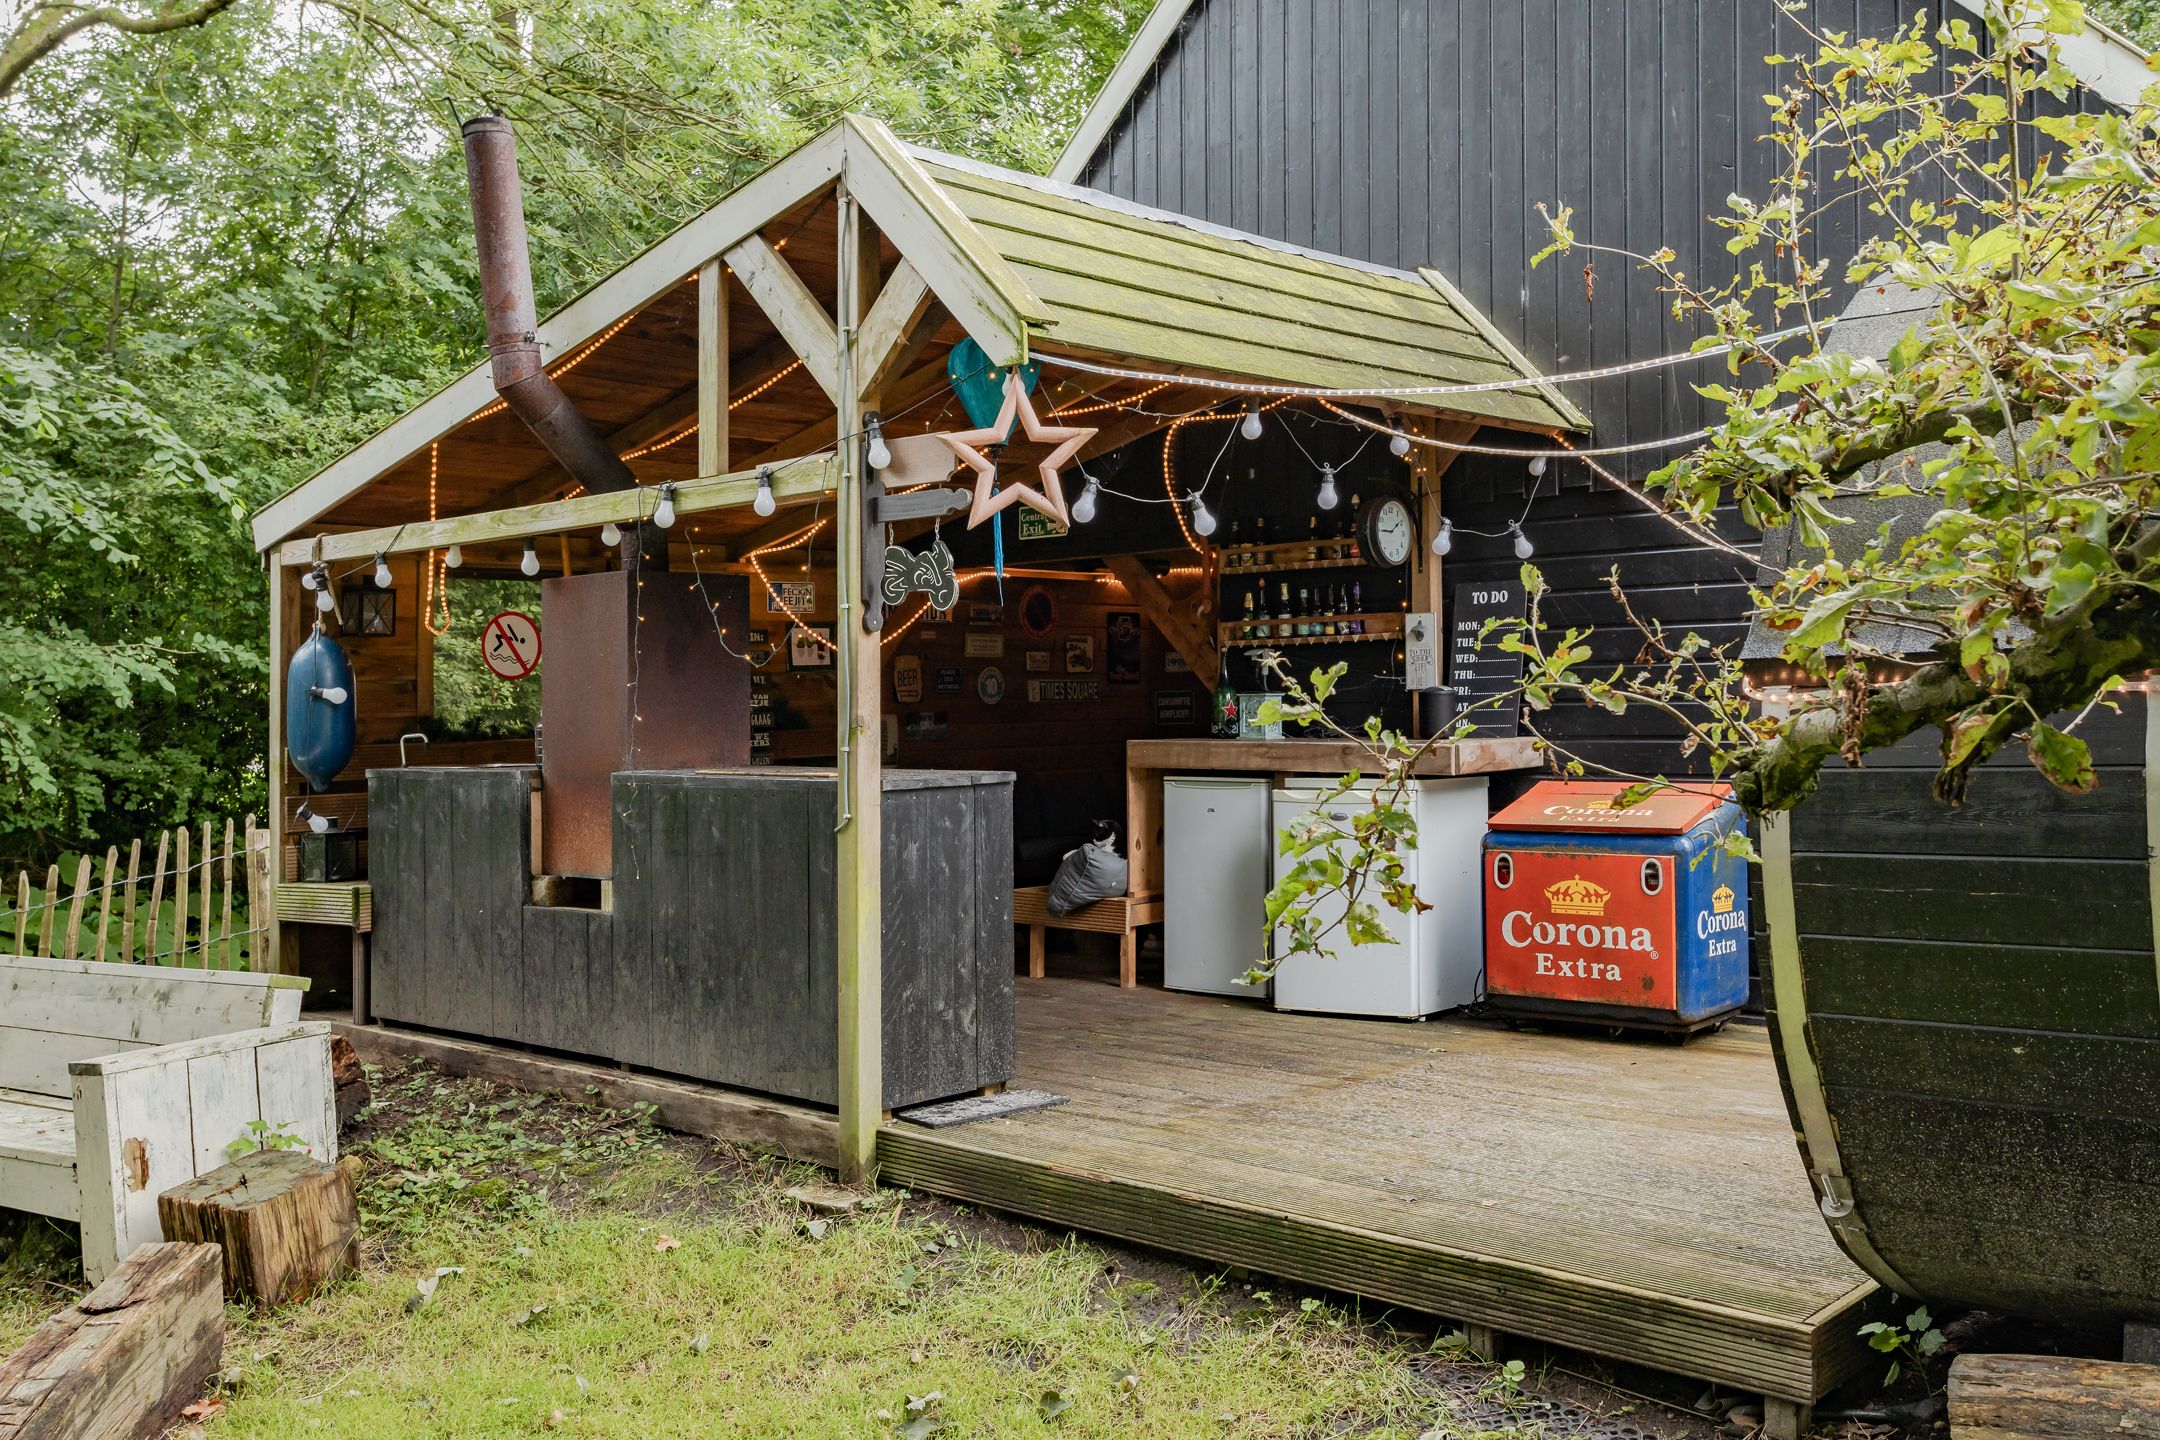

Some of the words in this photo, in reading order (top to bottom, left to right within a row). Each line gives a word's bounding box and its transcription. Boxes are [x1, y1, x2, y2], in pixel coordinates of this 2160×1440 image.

[1472, 592, 1488, 604] TO
[1490, 590, 1508, 604] DO
[1458, 622, 1480, 630] MON:
[1456, 638, 1477, 648] TUE:
[1409, 648, 1418, 656] TO
[1418, 648, 1432, 656] THE
[1456, 654, 1478, 664] WED:
[1414, 662, 1427, 672] LIFE
[898, 669, 918, 688] BEER
[1454, 670, 1476, 680] THU:
[986, 678, 998, 694] 10
[1040, 682, 1065, 700] TIMES
[1066, 681, 1098, 700] SQUARE
[1456, 702, 1471, 712] AT:
[1543, 803, 1654, 818] Corona
[1559, 812, 1622, 824] Extra
[1501, 910, 1655, 952] Corona
[1696, 908, 1746, 940] Corona
[1708, 938, 1738, 958] Extra
[1535, 952, 1623, 982] Extra
